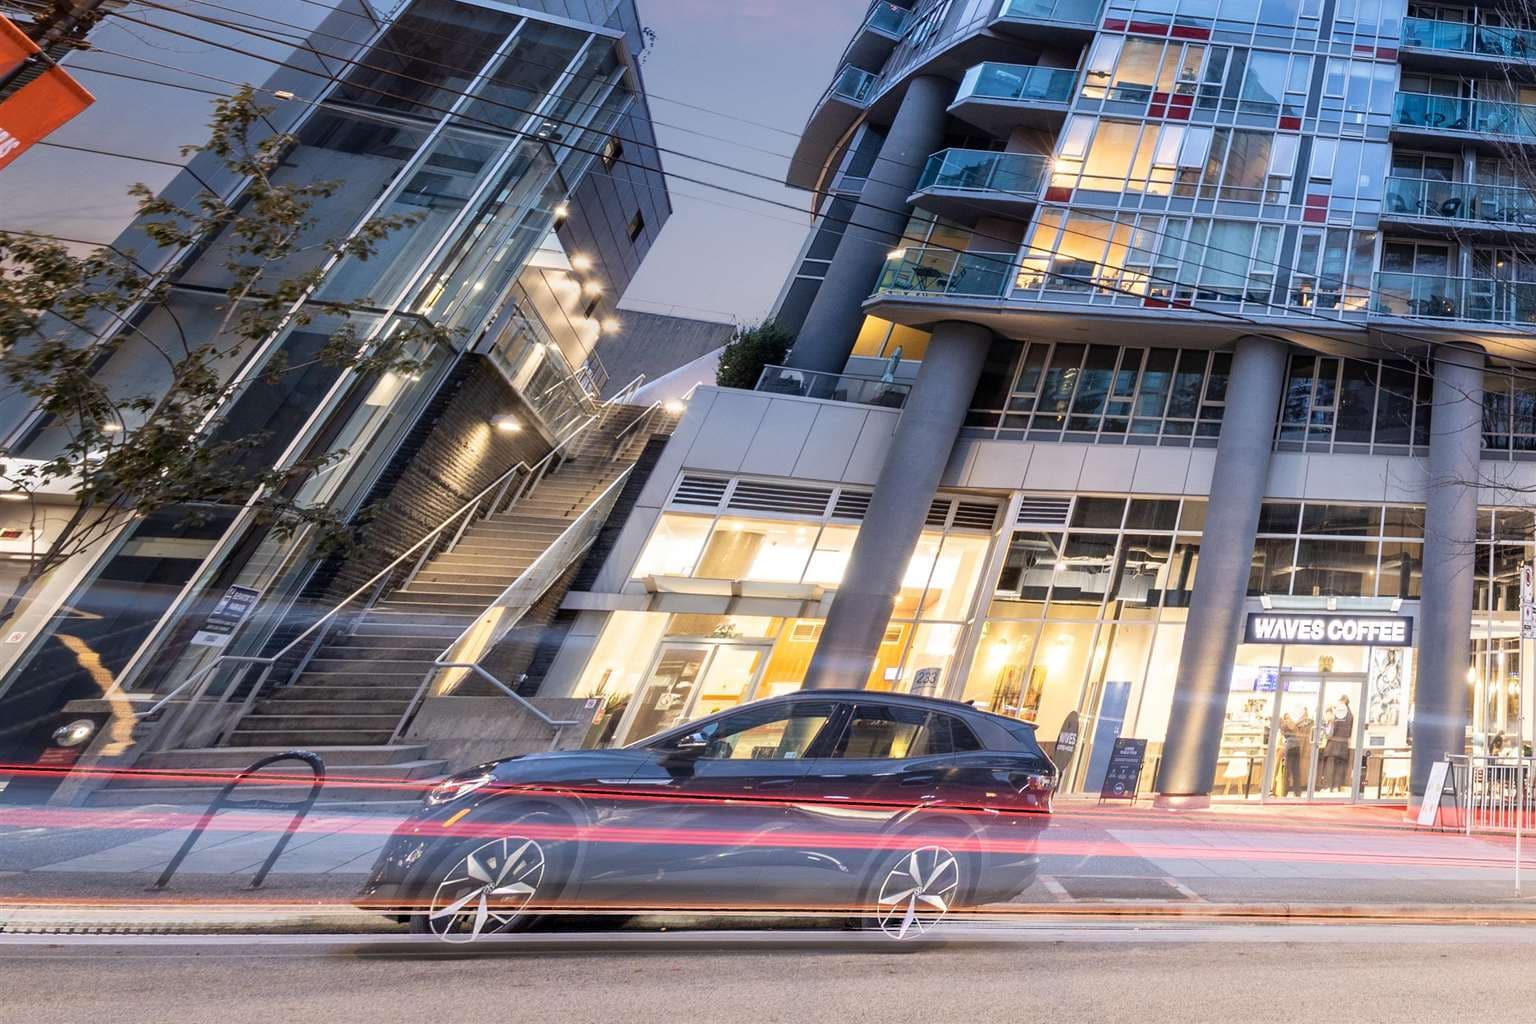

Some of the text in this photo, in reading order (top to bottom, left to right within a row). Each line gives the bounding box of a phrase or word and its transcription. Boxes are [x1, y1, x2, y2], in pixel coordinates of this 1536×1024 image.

[1254, 617, 1406, 642] WAVES COFFEE
[917, 671, 937, 684] 233
